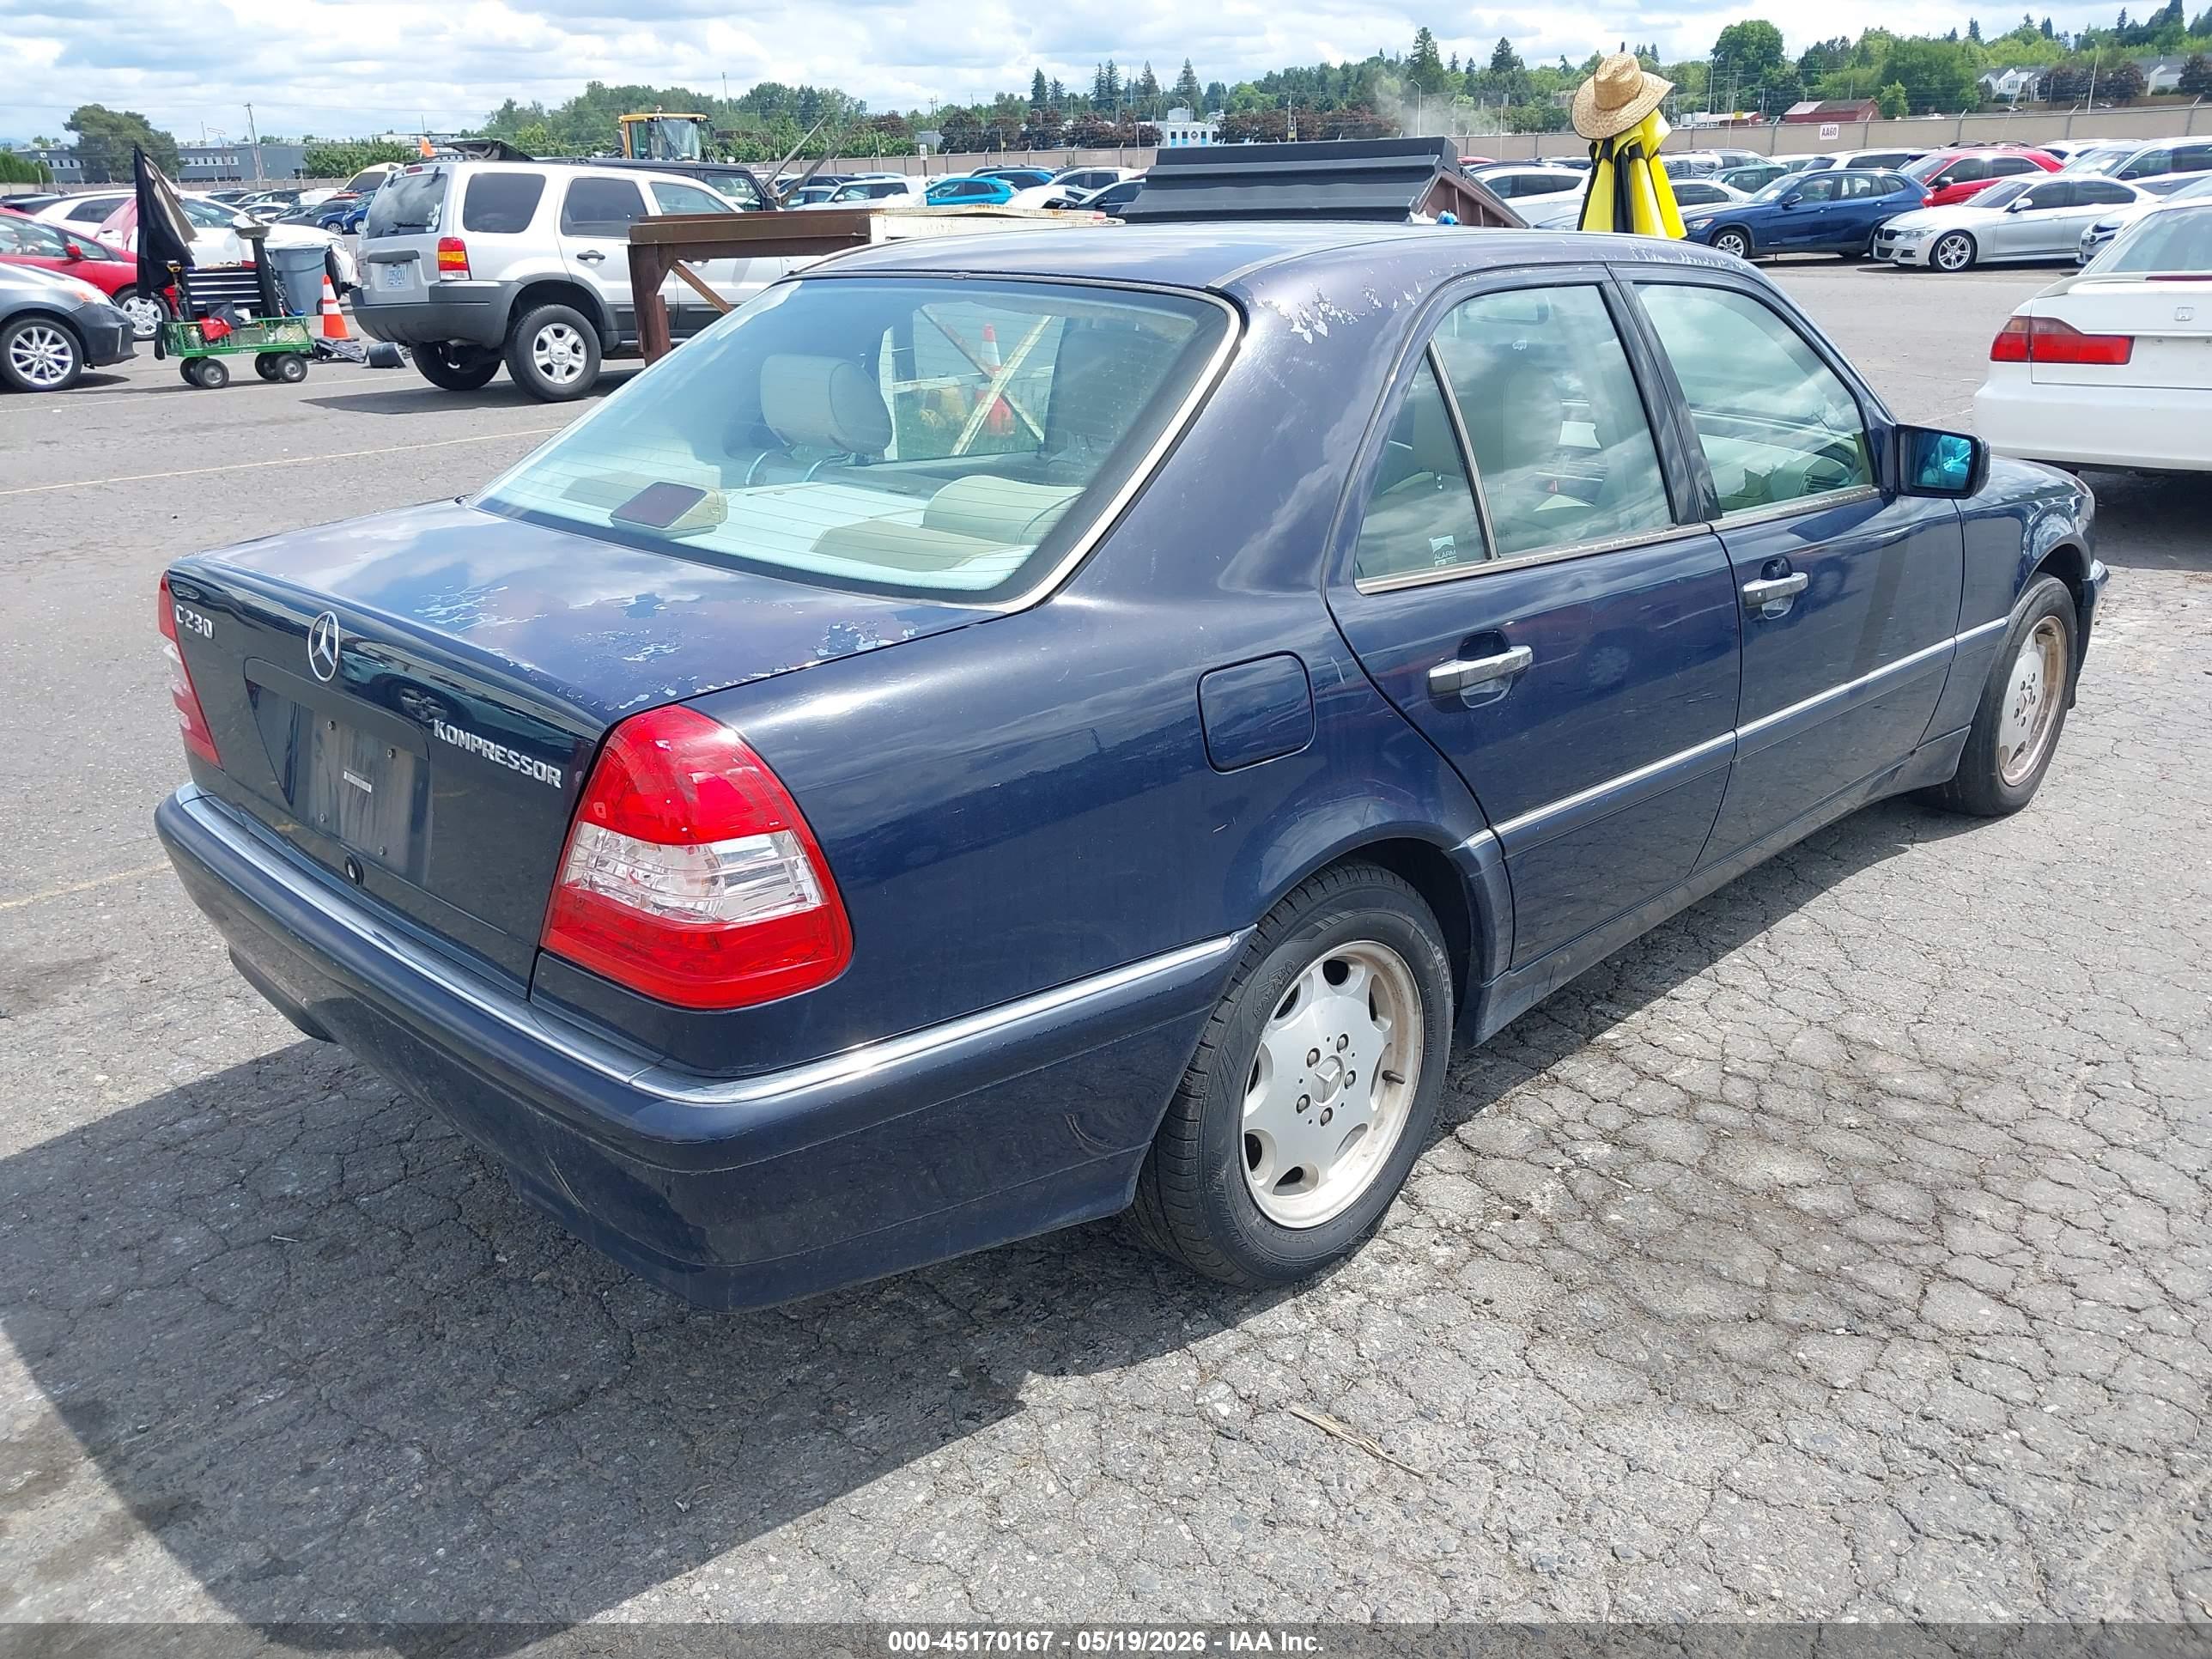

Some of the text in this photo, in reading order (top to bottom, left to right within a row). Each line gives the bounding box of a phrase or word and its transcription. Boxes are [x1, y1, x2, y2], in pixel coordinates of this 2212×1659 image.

[1821, 127, 1838, 137] AA60
[1434, 550, 1457, 561] ALARM
[434, 719, 562, 788] KOMPRESSOR
